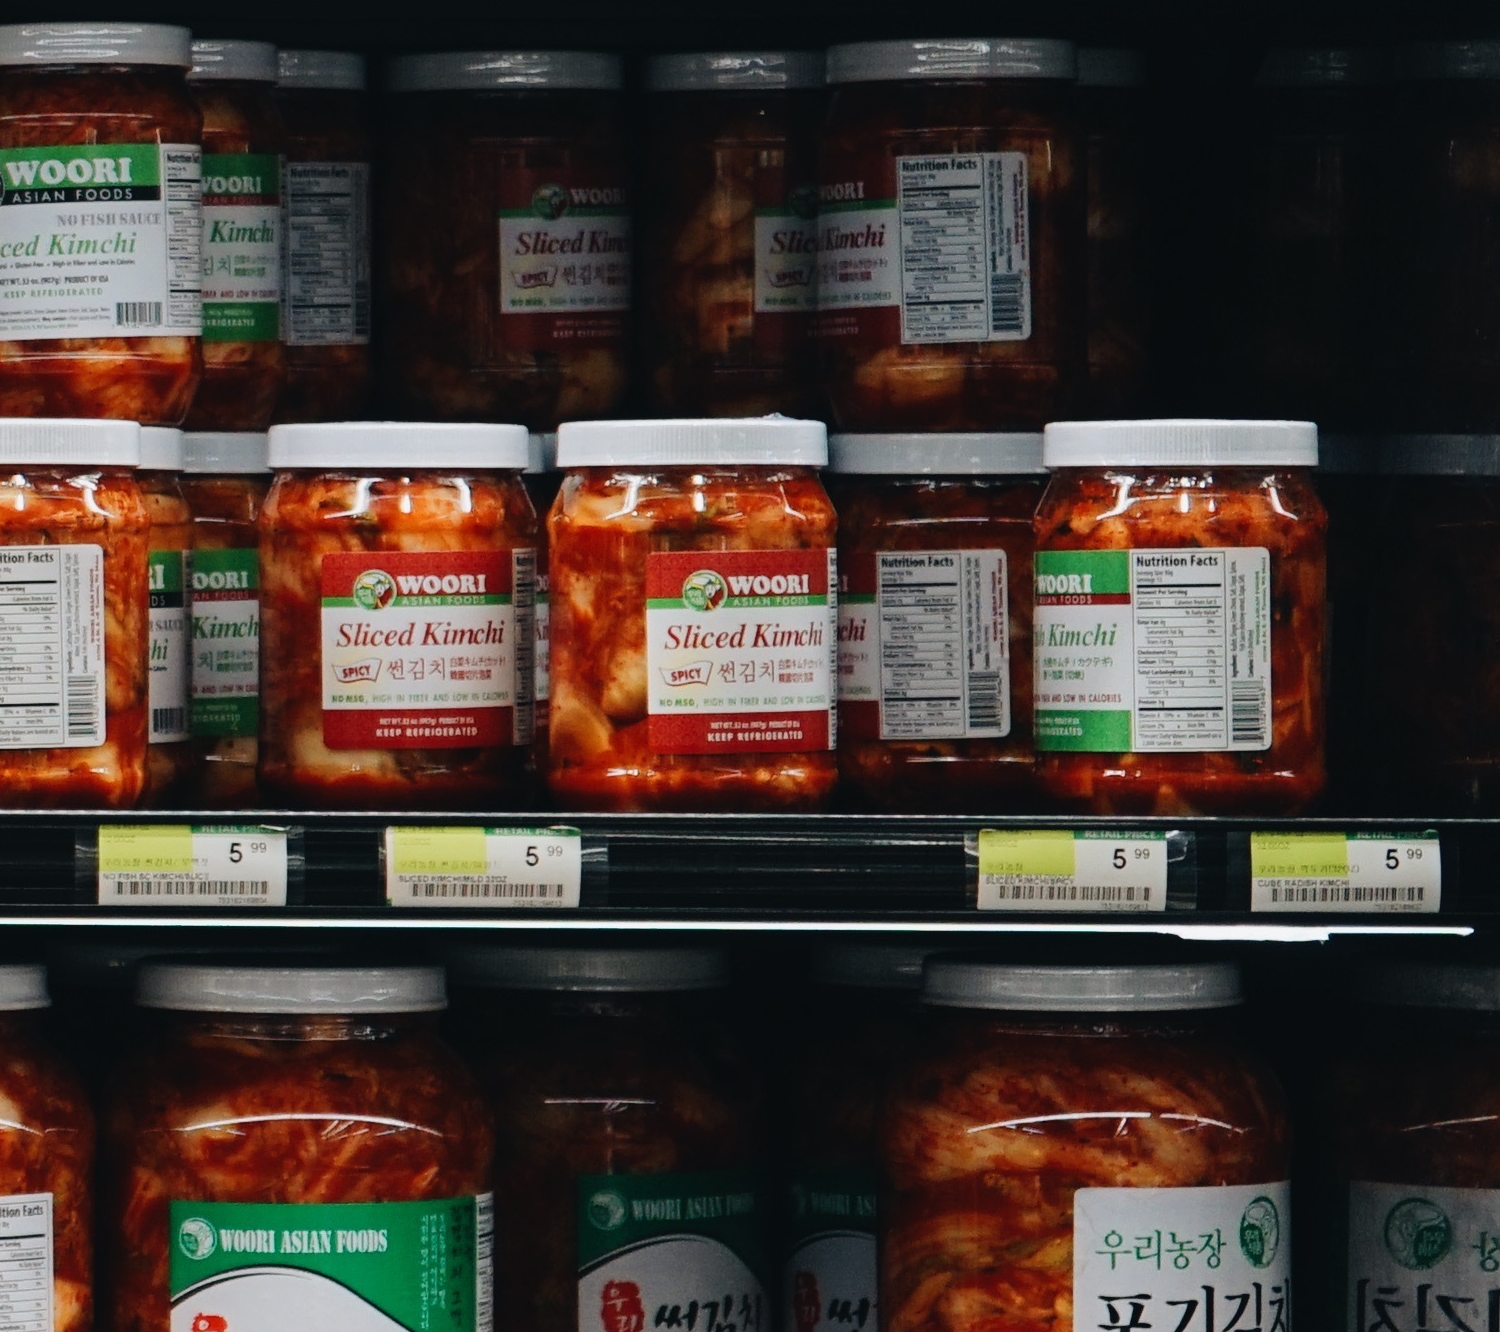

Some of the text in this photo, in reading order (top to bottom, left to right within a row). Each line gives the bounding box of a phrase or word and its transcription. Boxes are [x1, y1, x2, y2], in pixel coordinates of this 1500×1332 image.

[6, 156, 132, 185] WOORI
[12, 187, 133, 204] ASIAN FOODS
[47, 233, 136, 256] Kimchi
[397, 574, 485, 595] WOORI
[336, 621, 505, 648] Sliced Kimchi
[342, 666, 371, 679] SPICY
[230, 842, 267, 862] 5 99
[1096, 1229, 1226, 1270] 우리농장
